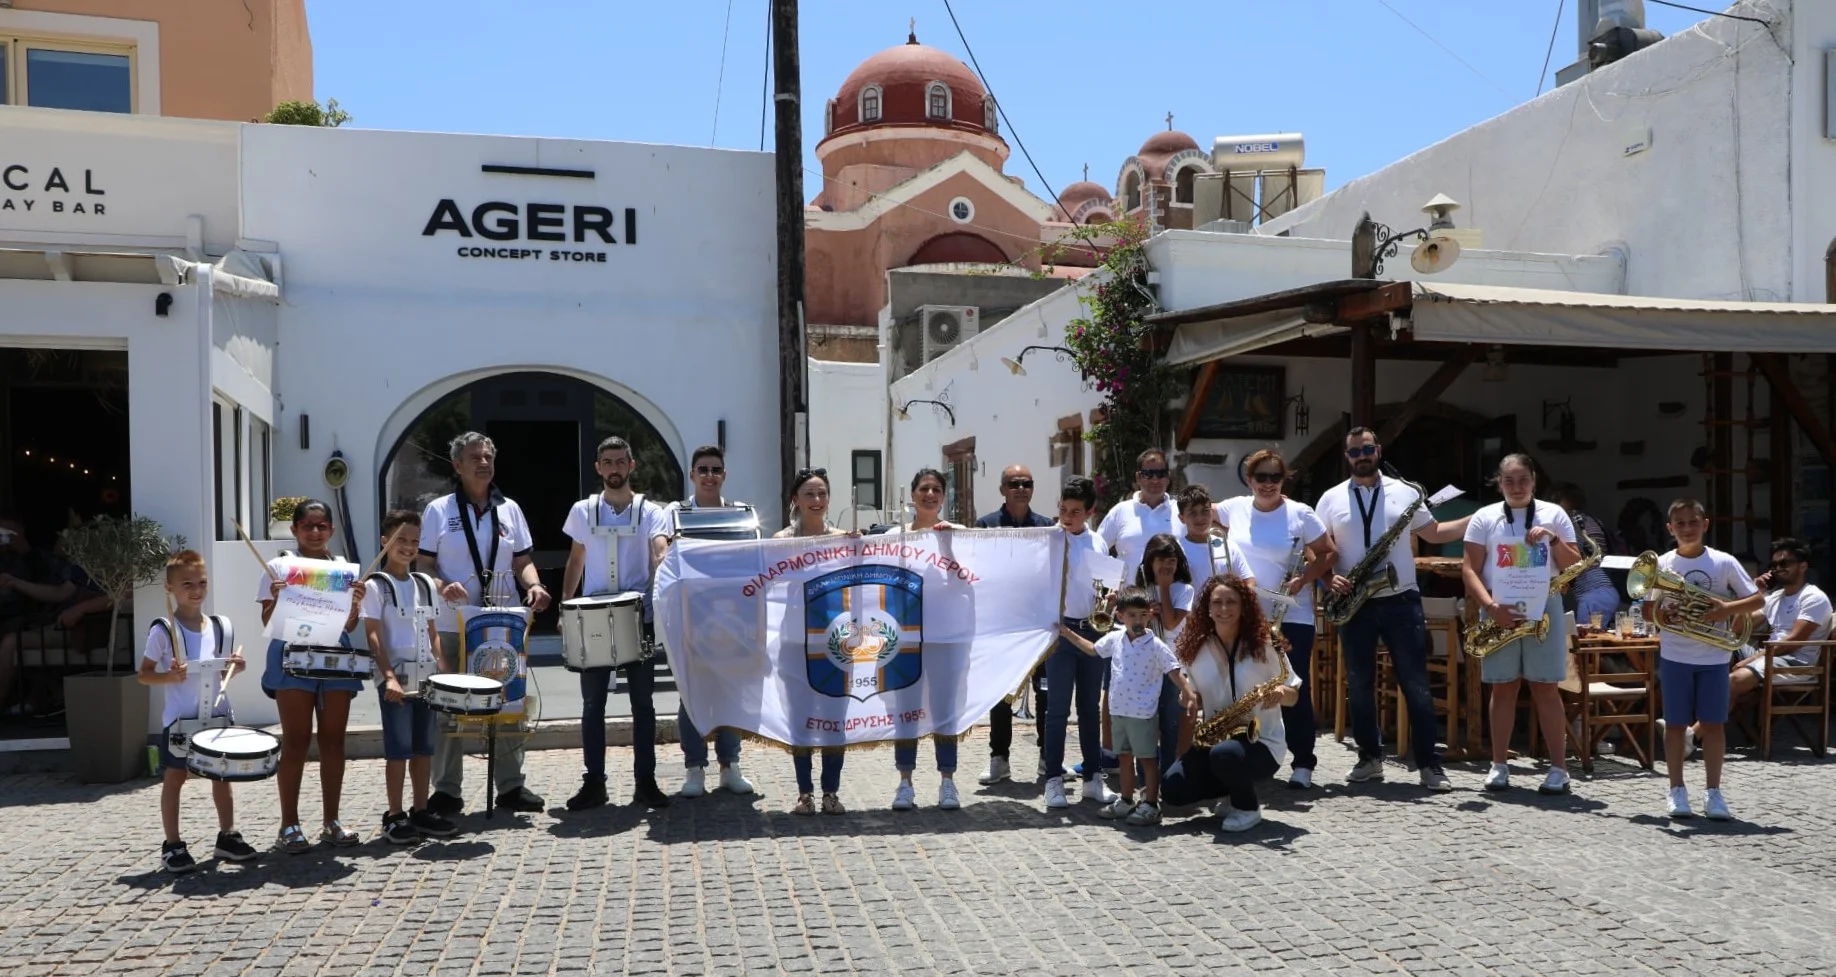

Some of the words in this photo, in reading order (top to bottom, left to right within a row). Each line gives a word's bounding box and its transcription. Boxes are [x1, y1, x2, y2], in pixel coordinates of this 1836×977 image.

[1234, 142, 1278, 154] NOBEL
[52, 201, 106, 215] BAR
[422, 198, 637, 245] AGERI
[457, 247, 542, 260] CONCEPT
[550, 250, 607, 263] STORE
[741, 545, 857, 598] ΦΙΛΑΡΜΟΝΙΚΗ
[861, 544, 925, 560] ΔΗΜΟΥ
[925, 555, 980, 586] ΛΕΡΟΥ
[850, 676, 878, 688] 1955
[806, 717, 840, 732] ΕΤΟΣ
[843, 713, 895, 731] ΙΔΡΥΣΗΣ
[899, 708, 926, 724] 1955
